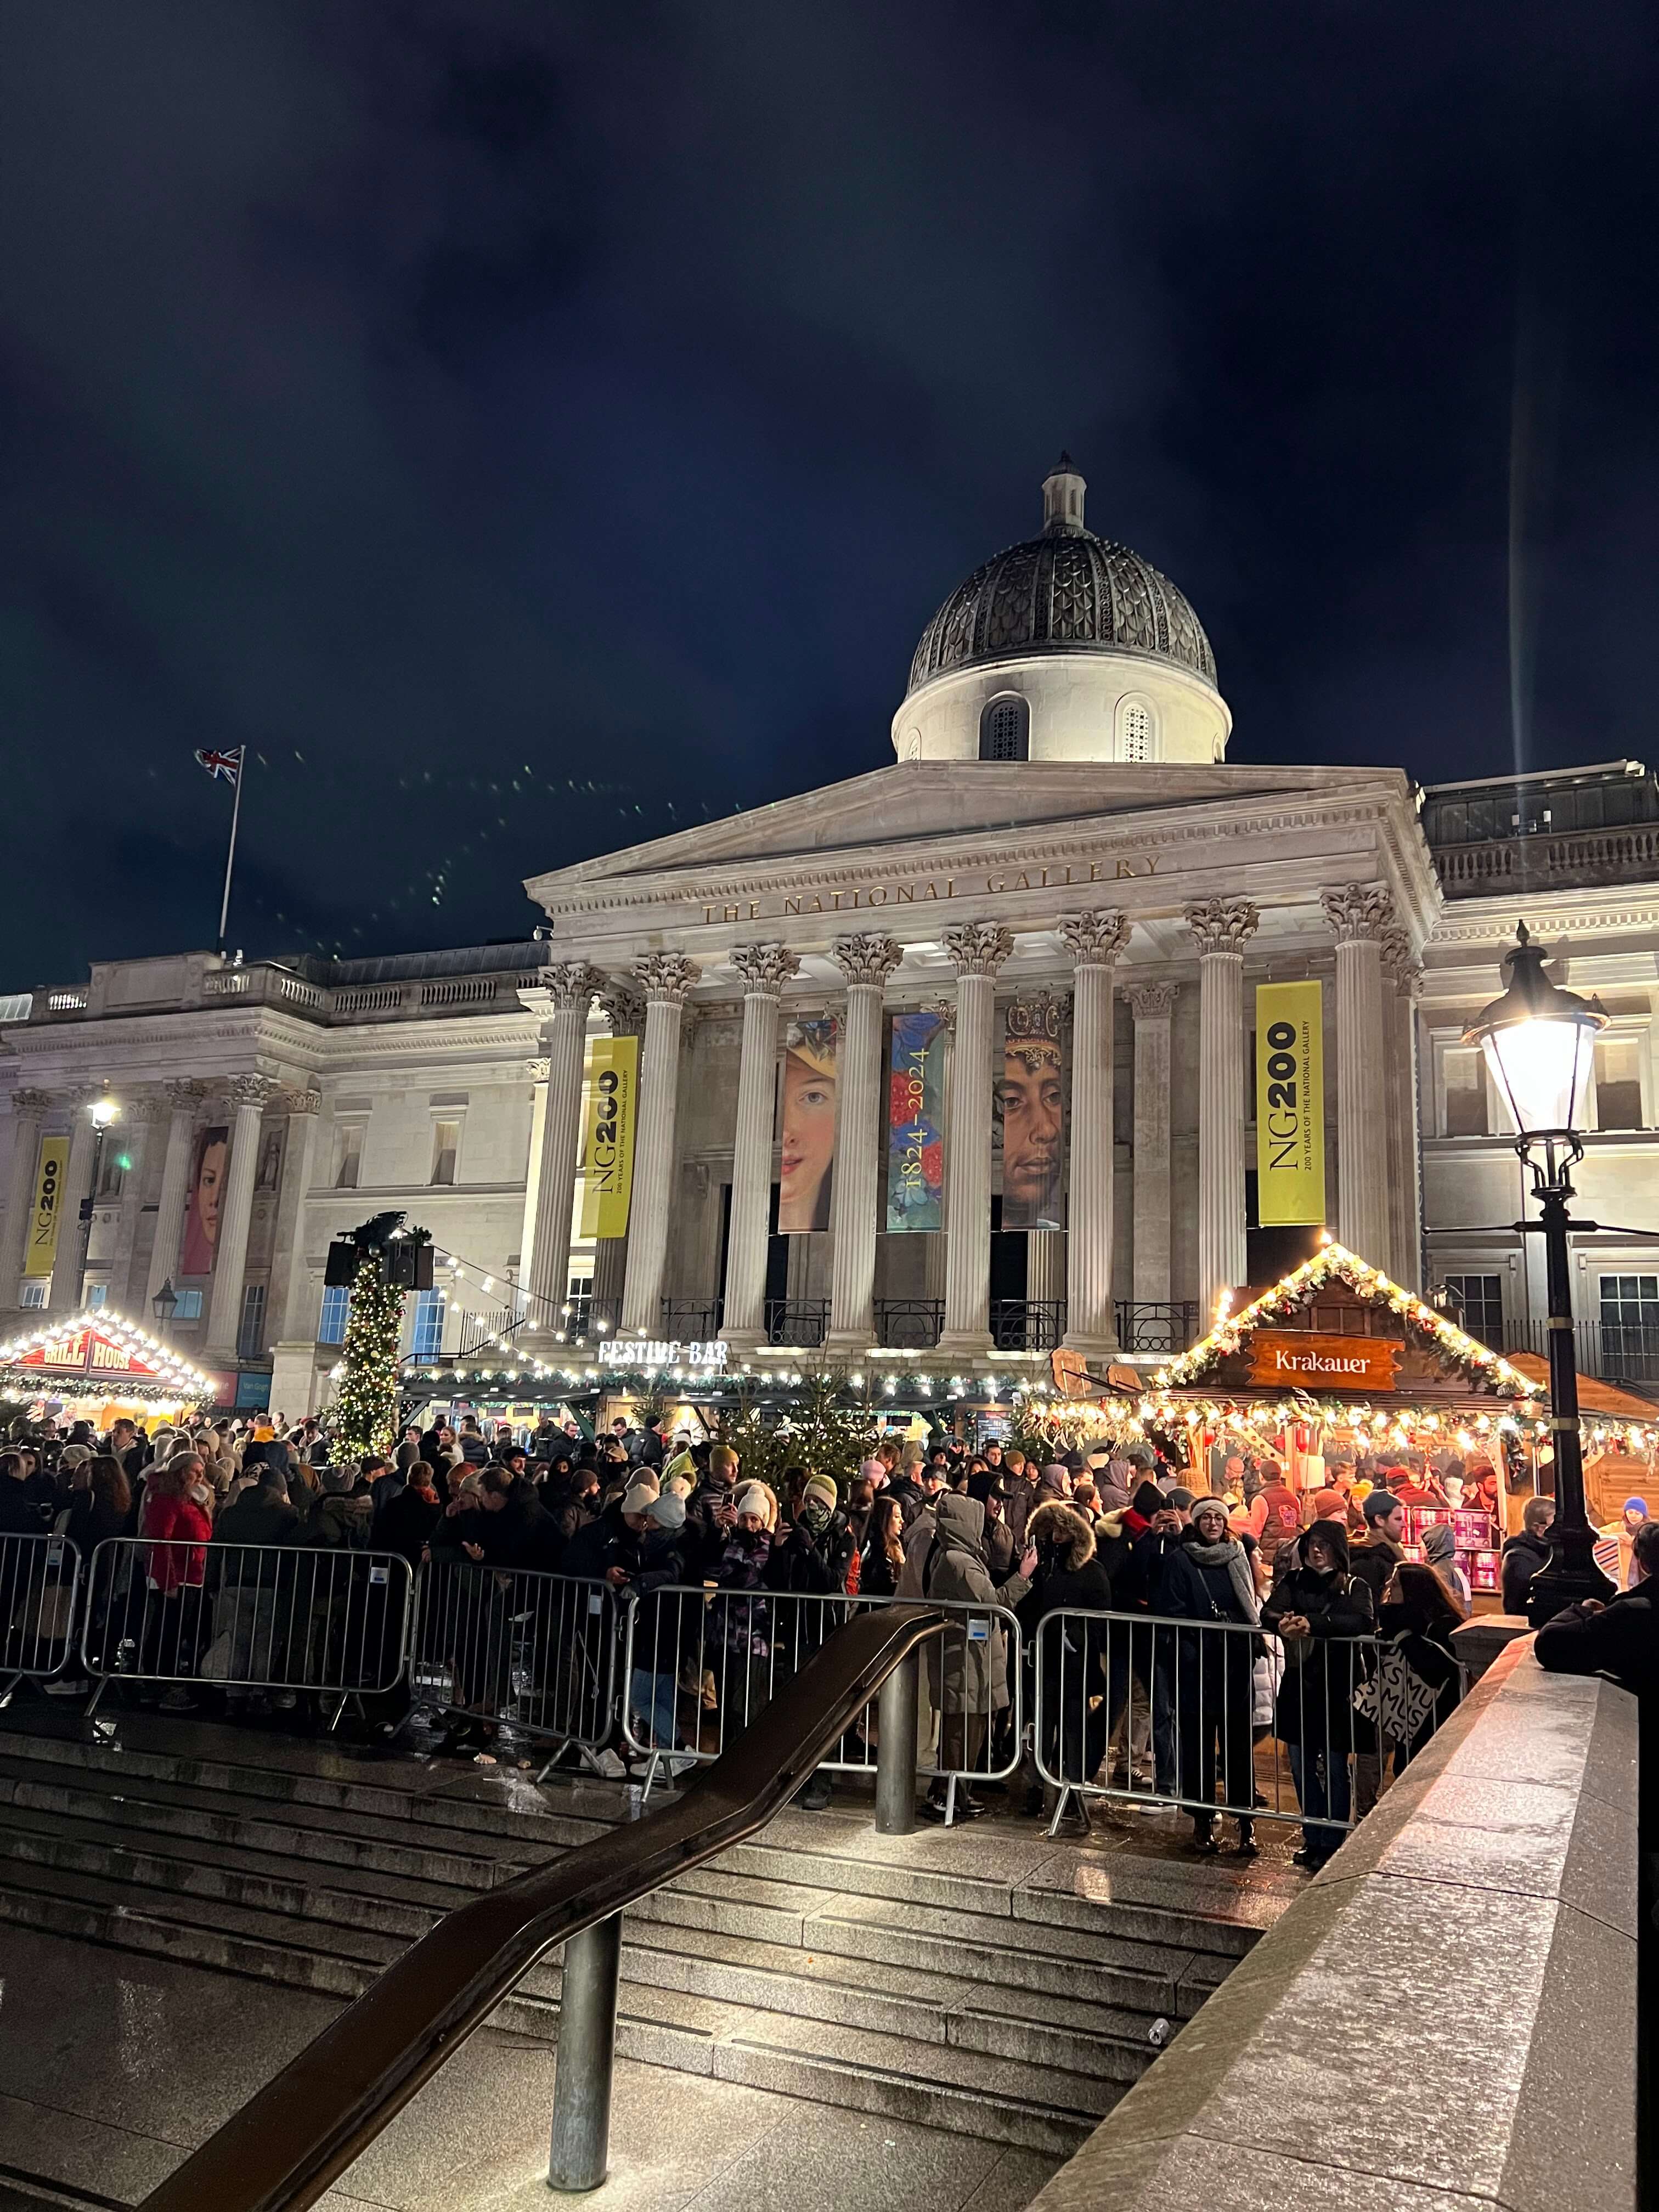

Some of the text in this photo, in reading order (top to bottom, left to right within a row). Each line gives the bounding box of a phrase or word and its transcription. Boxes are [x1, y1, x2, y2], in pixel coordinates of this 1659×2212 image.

[702, 855, 1160, 923] THE NATIONAL GALLERY
[1301, 1020, 1310, 1054] GALLERY
[1302, 1056, 1311, 1097] NATIONAL
[1267, 1022, 1299, 1171] NG200
[592, 1070, 618, 1194] NG200
[1304, 1115, 1311, 1127] OF
[619, 1148, 624, 1158] OF
[35, 1160, 58, 1245] NG200
[44, 1341, 131, 1370] GRILL HOUSE
[599, 1341, 729, 1364] FESTIVE BAR
[1276, 1350, 1371, 1374] Krakauer
